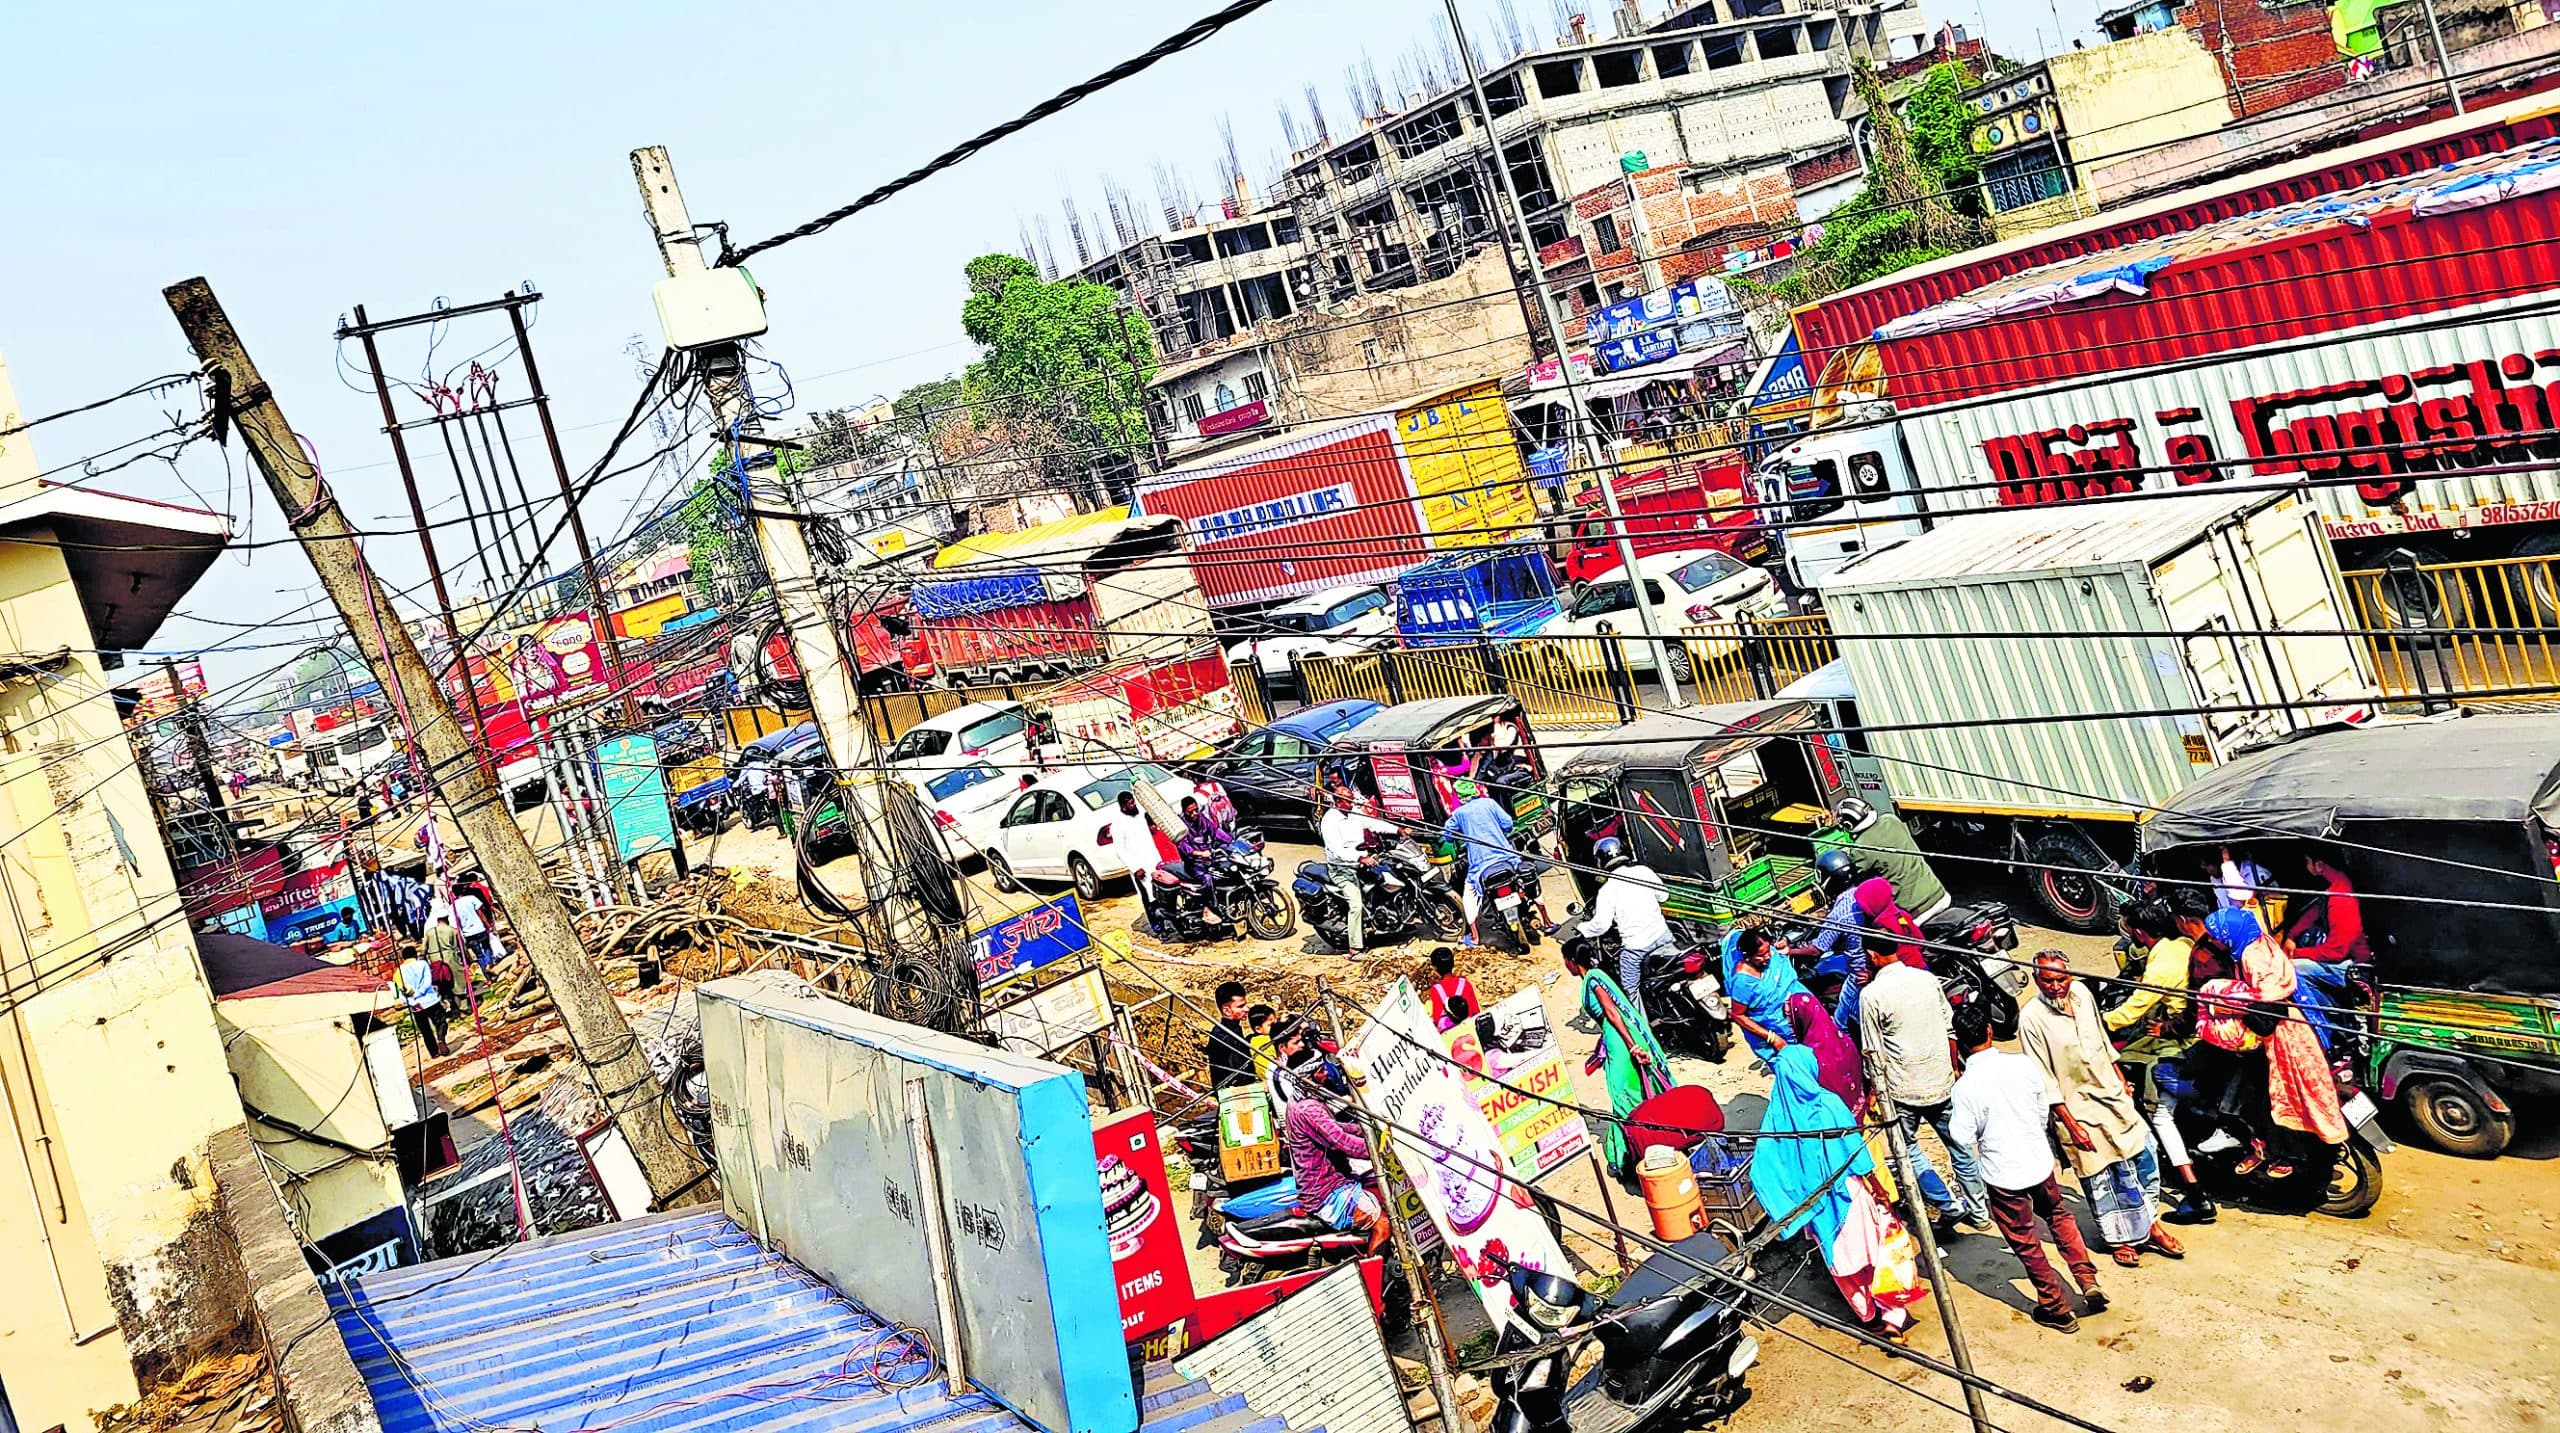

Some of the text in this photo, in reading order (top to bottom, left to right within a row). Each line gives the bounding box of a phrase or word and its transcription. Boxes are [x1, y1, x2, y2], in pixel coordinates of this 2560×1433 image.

[304, 922, 326, 934] TRUE
[1371, 1028, 1420, 1085] Happy
[1121, 1269, 1163, 1300] ITEMS
